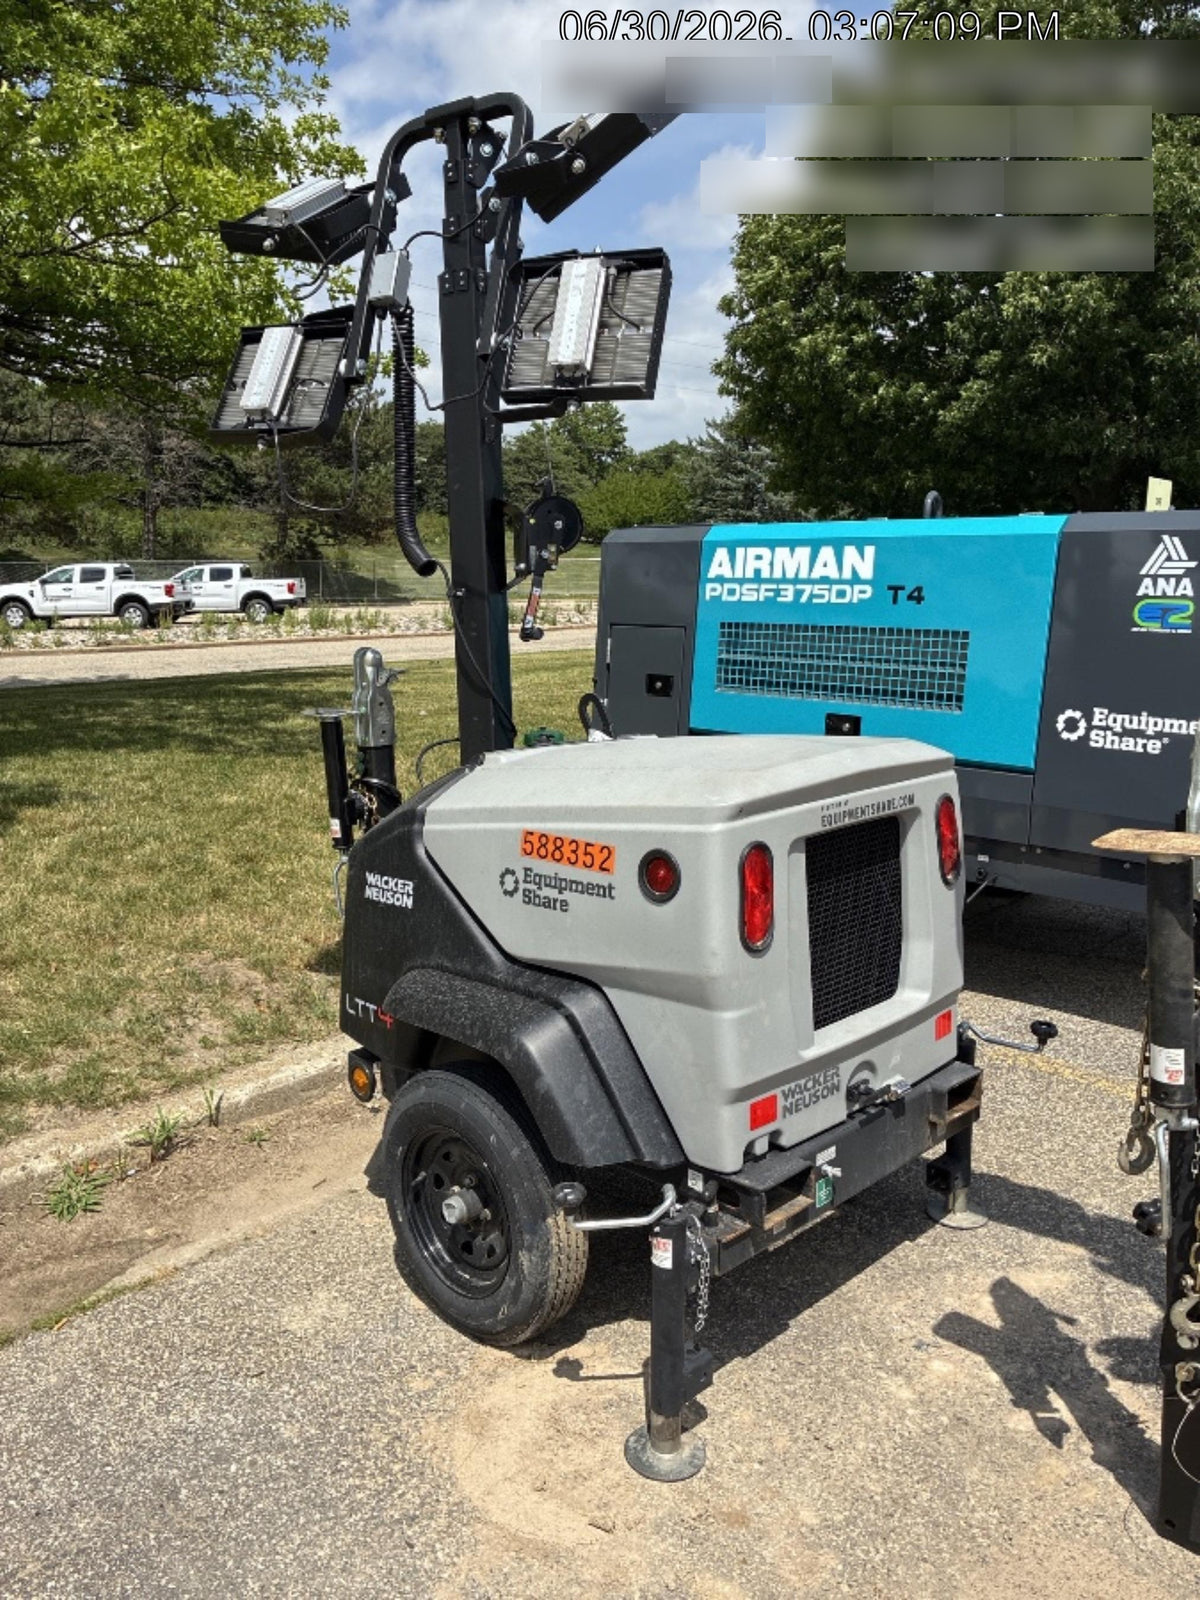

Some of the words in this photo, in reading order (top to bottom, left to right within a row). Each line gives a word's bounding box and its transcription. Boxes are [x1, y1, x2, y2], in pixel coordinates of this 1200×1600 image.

[707, 545, 875, 580] AIRMAN
[705, 582, 873, 604] PDSF375DP
[887, 585, 925, 605] T4
[1136, 577, 1194, 597] ANA
[821, 792, 915, 828] EQUIPMENTSHARE.COM
[521, 831, 612, 872] 588352
[364, 885, 413, 909] NEUSON
[365, 871, 414, 895] WACKER
[522, 866, 616, 900] Equipment
[521, 888, 569, 913] Share
[346, 993, 394, 1029] LTT4
[781, 1066, 840, 1102] WACKER
[782, 1079, 840, 1119] NEUSON
